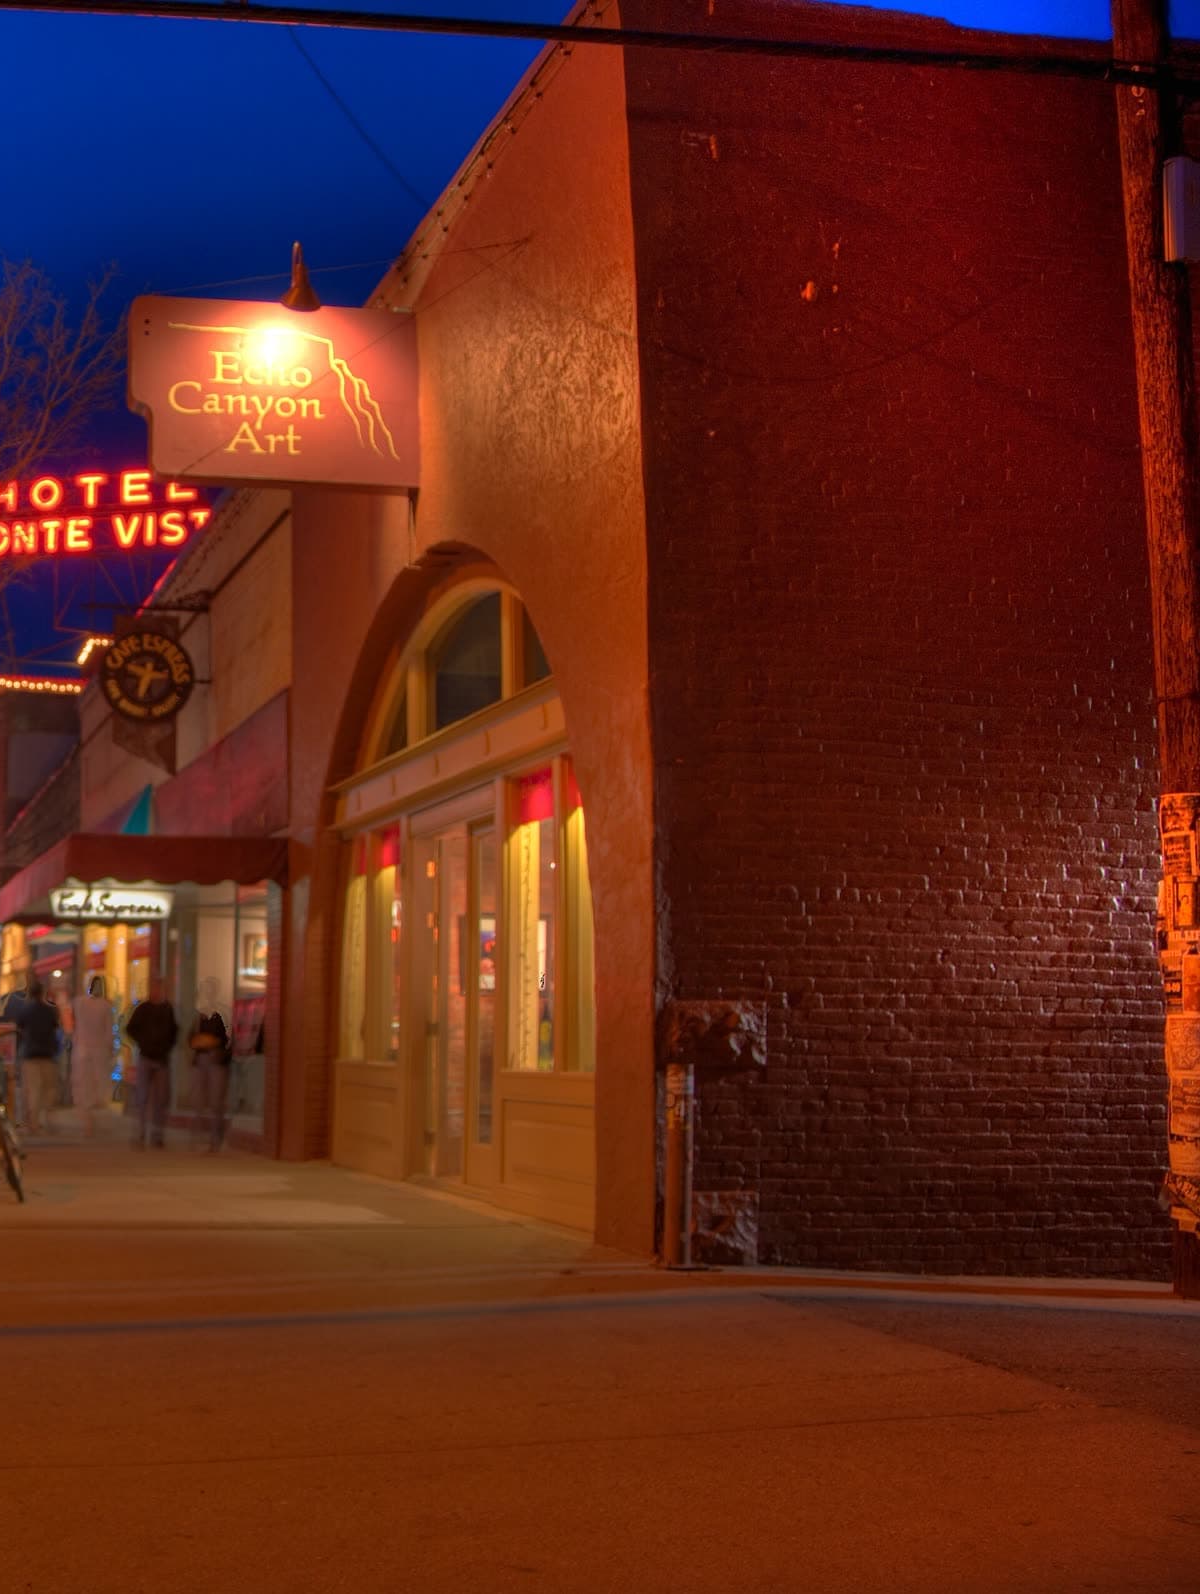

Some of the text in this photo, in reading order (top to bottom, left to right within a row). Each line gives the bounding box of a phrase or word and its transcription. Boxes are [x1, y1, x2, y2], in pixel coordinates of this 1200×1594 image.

[209, 350, 313, 388] Echo
[168, 380, 325, 430] Canyon
[223, 421, 302, 455] Art
